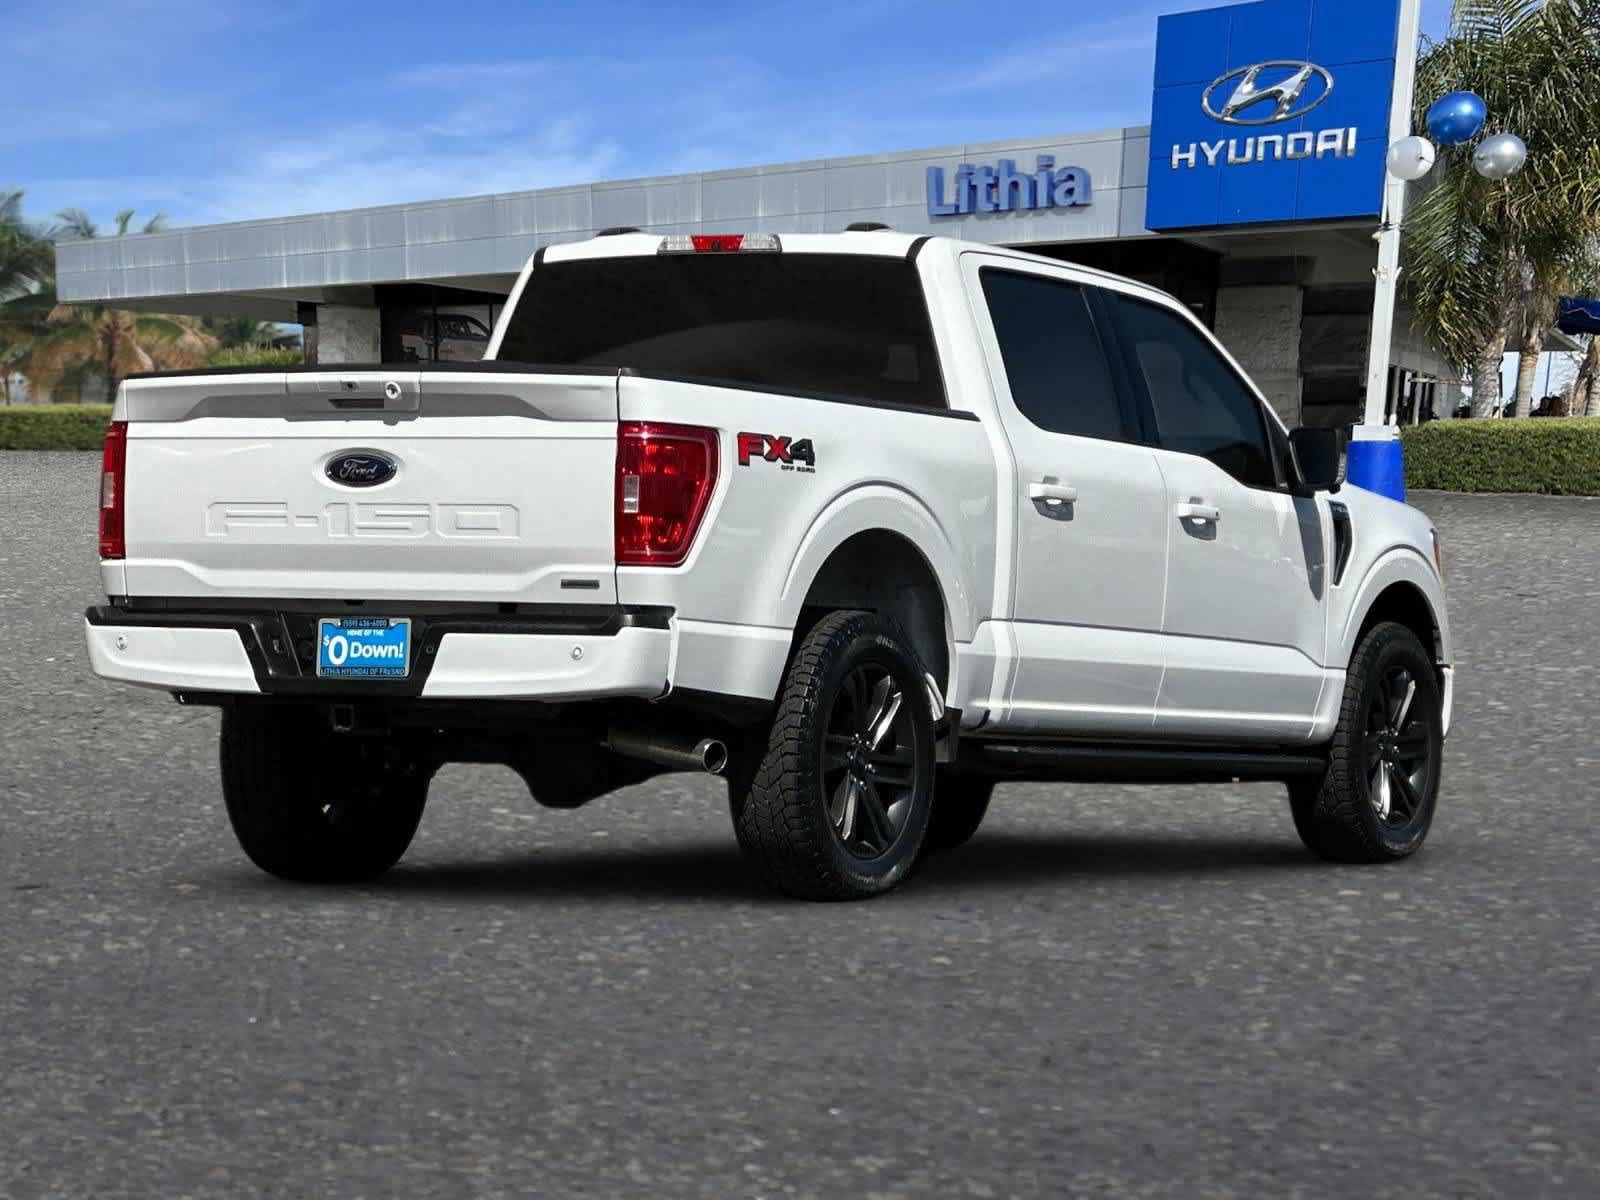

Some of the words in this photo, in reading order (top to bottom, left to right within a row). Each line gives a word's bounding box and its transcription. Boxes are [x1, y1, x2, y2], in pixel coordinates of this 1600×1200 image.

[1171, 127, 1357, 169] HYUNDAI
[926, 155, 1093, 217] Lithia
[737, 431, 815, 466] FX4
[339, 458, 378, 478] Ford
[205, 502, 520, 539] F-150
[350, 641, 404, 658] Down!
